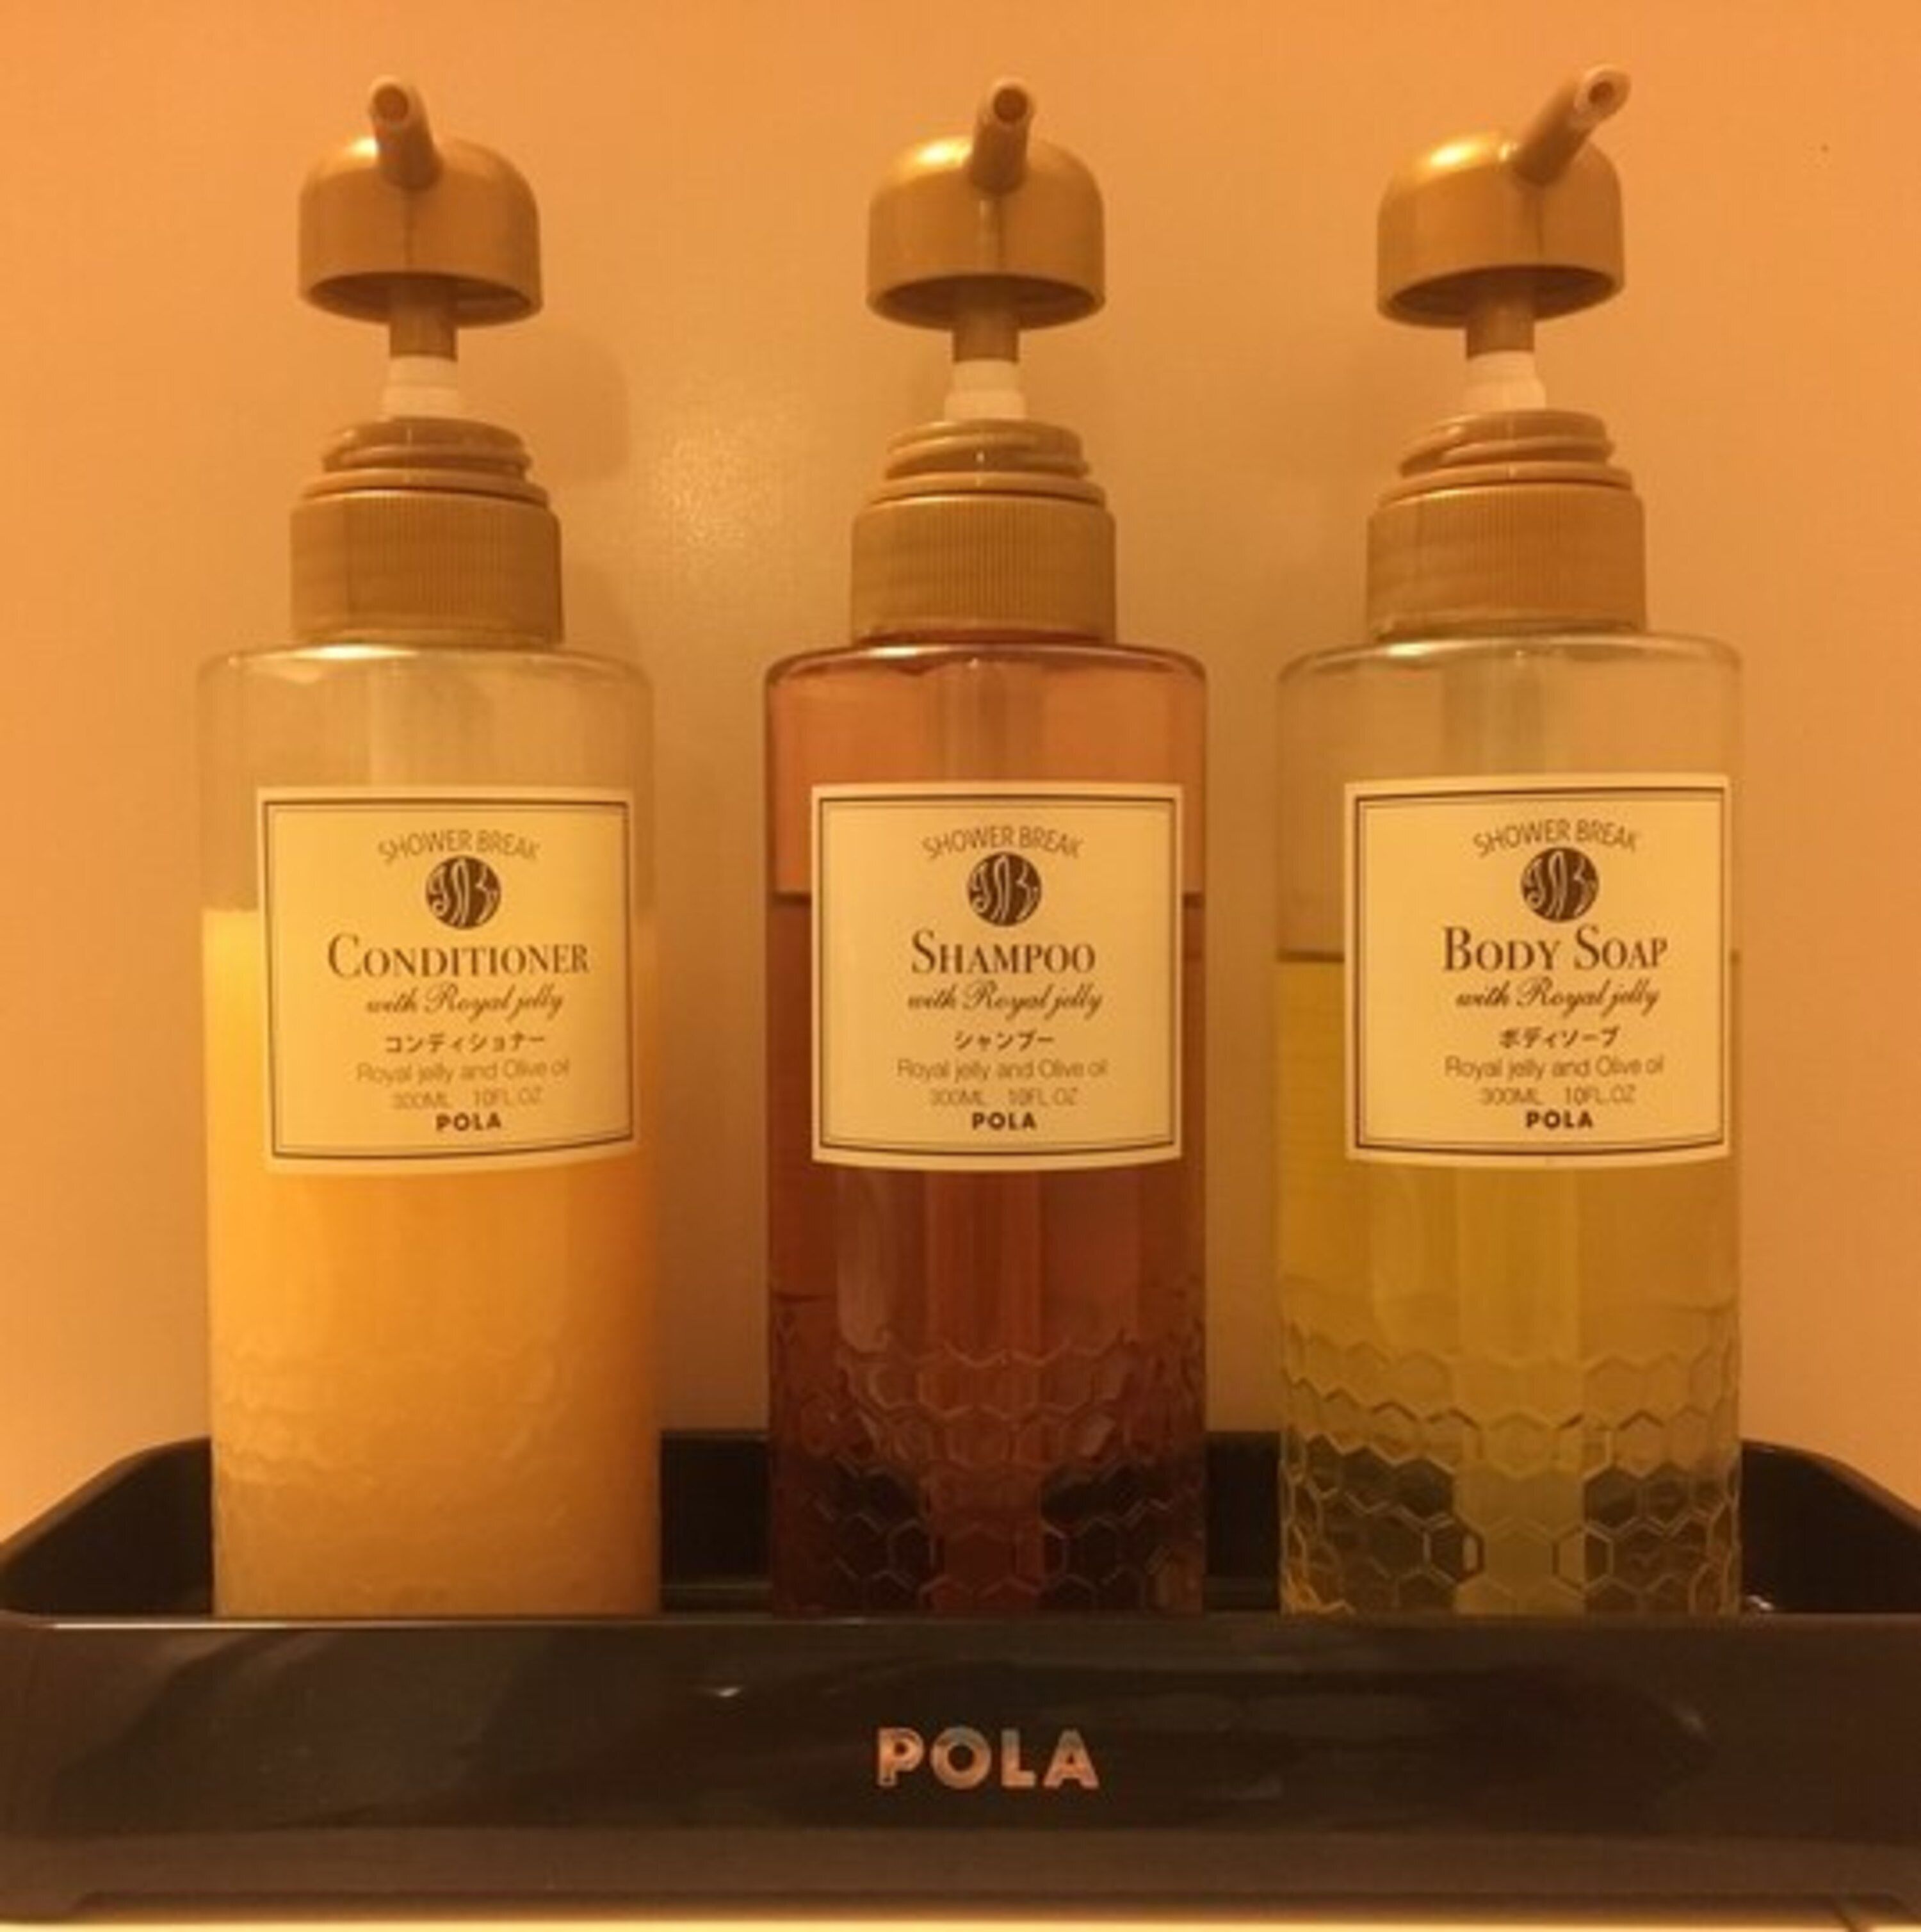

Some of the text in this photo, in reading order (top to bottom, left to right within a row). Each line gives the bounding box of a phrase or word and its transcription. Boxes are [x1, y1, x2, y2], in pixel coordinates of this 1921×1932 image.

[377, 829, 540, 865] SHOWER BREAK
[921, 827, 1085, 859] SHOWER BREAK
[1473, 819, 1639, 858] SHOWER BREAK
[366, 982, 564, 1023] with Royal jelly
[907, 980, 1103, 1021] with Royal jelly
[1455, 976, 1661, 1019] with Royal jelly
[385, 1031, 546, 1054] コンディショナー
[953, 1028, 1055, 1051] シャンプー
[1498, 1025, 1621, 1049] ボディソープ
[356, 1062, 413, 1087] Royal
[416, 1061, 455, 1087] jelly
[460, 1060, 498, 1082] and
[502, 1058, 547, 1080] Olive
[897, 1057, 950, 1082] Royal
[953, 1060, 991, 1085] jelly
[997, 1059, 1034, 1080] and
[1037, 1057, 1084, 1080] Olive
[1445, 1055, 1504, 1084] Royal
[1507, 1057, 1546, 1082] jelly
[1552, 1057, 1591, 1078] and
[1594, 1054, 1642, 1077] Olive
[435, 1112, 502, 1132] POLA
[971, 1111, 1037, 1131] POLA
[1525, 1110, 1594, 1129] POLA
[877, 1726, 1099, 1790] POLA
